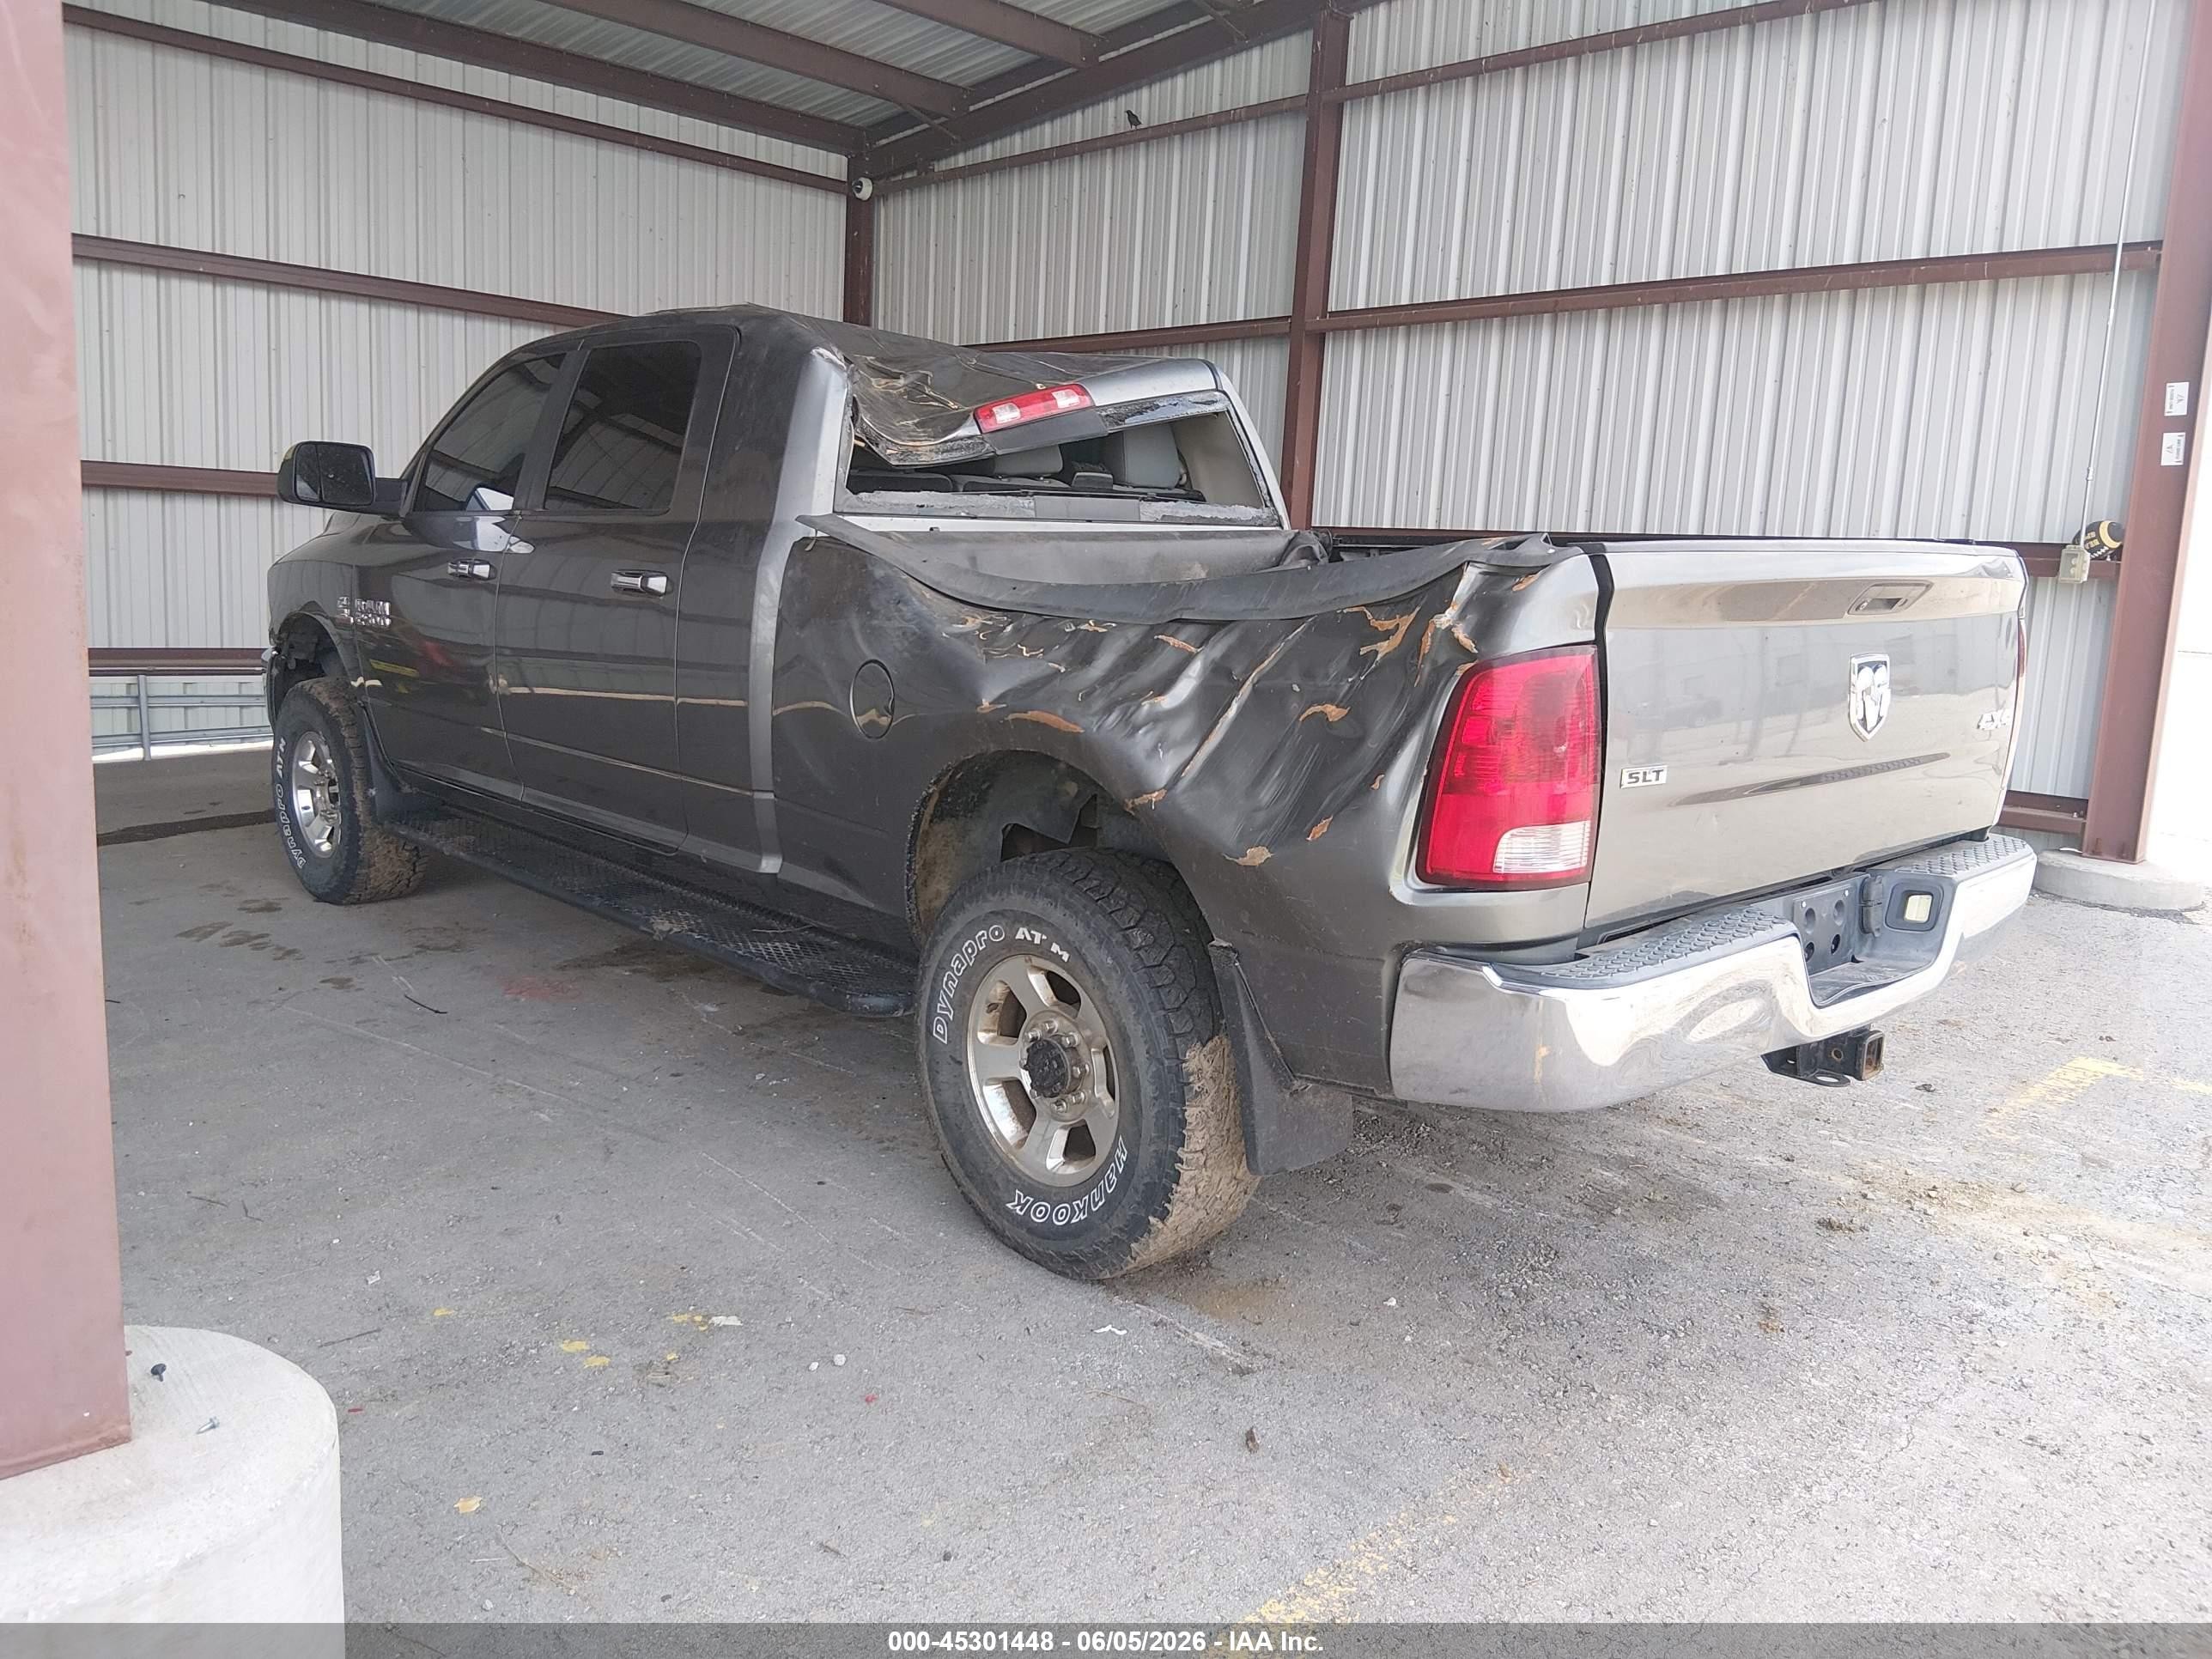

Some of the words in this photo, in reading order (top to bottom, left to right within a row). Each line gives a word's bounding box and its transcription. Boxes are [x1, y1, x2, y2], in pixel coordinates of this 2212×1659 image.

[1626, 769, 1664, 785] SLT
[933, 925, 1006, 1045] Dynapro
[1015, 927, 1048, 945] AT
[1050, 942, 1071, 963] M
